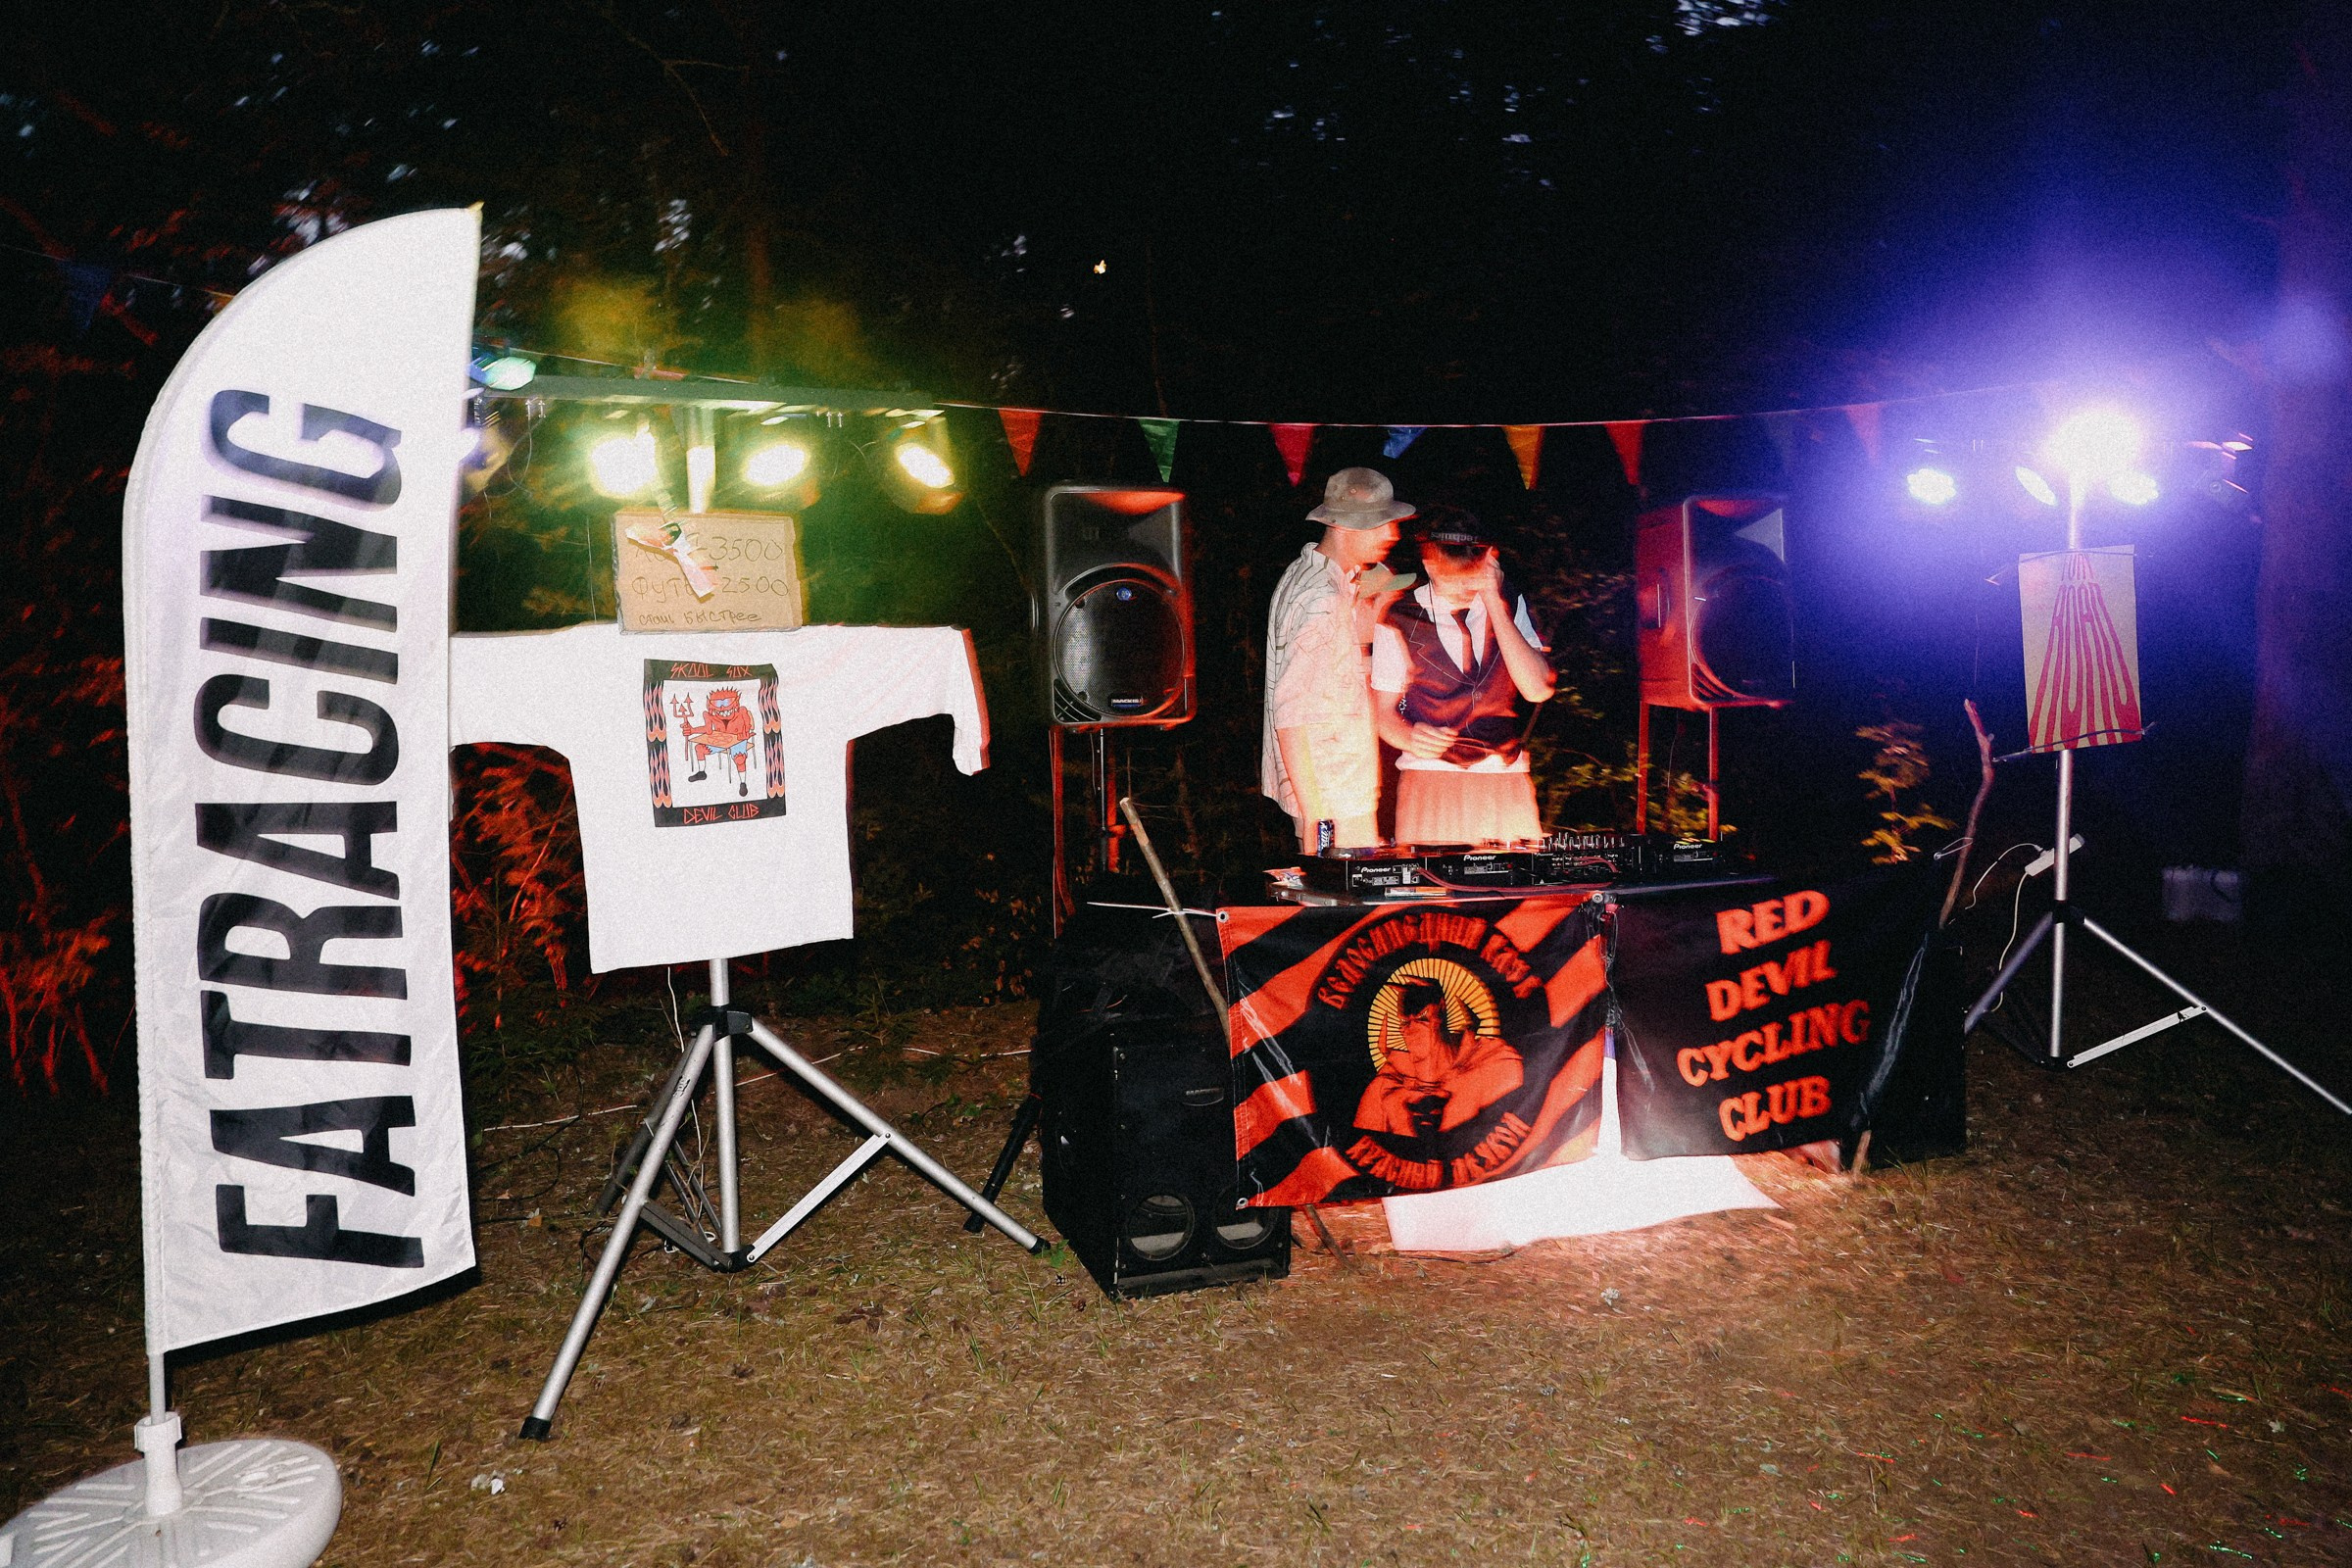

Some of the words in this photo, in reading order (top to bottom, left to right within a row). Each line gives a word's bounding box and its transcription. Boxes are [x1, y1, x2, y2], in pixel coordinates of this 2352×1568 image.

[709, 536, 783, 562] 3500
[722, 576, 789, 596] 2500
[670, 662, 714, 678] SKOOL
[193, 388, 425, 1268] FATRACING
[683, 807, 723, 825] DEVIL
[727, 803, 760, 820] CLUB
[1714, 889, 1832, 956] RED
[1704, 939, 1838, 1022] DEVIL
[1676, 999, 1872, 1087] CYCLING
[1718, 1074, 1833, 1142] CLUB
